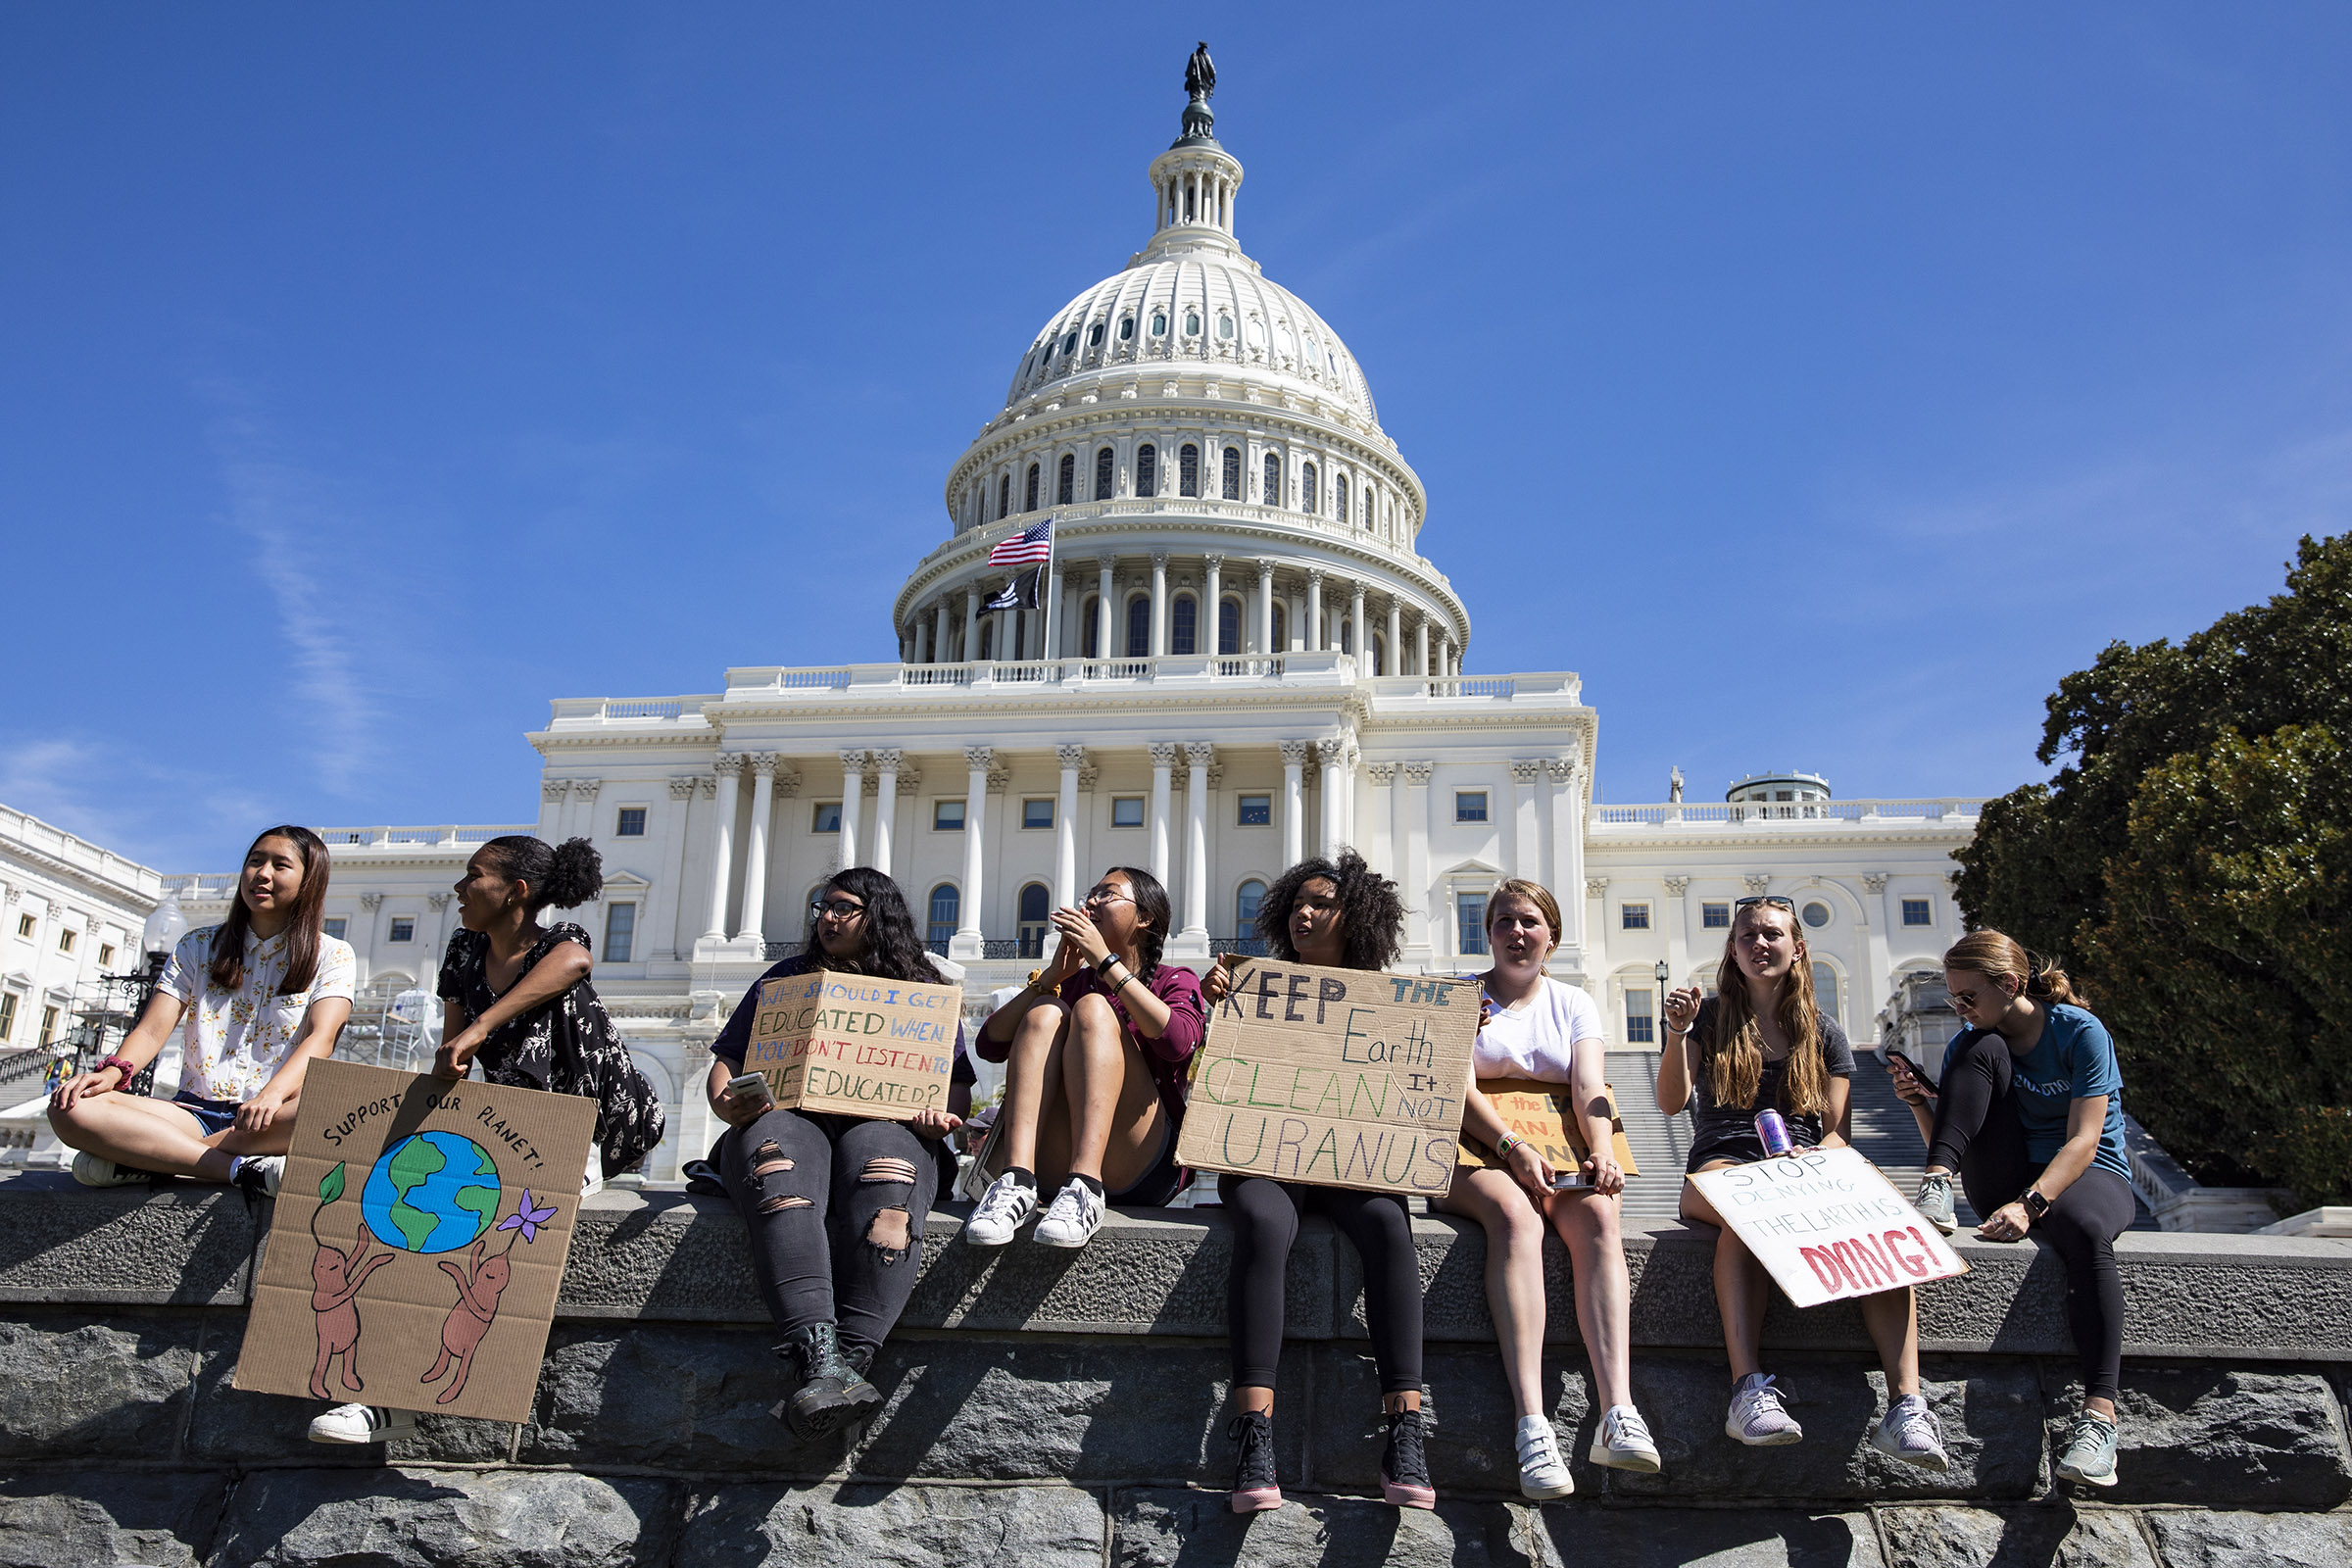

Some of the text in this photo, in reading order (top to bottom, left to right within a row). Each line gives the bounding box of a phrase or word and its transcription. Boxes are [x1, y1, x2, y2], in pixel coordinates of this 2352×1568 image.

[760, 981, 950, 1008] WHY SHOULD I GET
[1223, 963, 1454, 1024] KEEP THE
[760, 1007, 945, 1043] EDUCATED WHEN
[1343, 1007, 1434, 1068] Earth
[755, 1037, 950, 1074] YOU DON'T LISTEN TO
[807, 1066, 941, 1108] EDUCATED?
[1204, 1057, 1390, 1119] CLEAN
[1510, 1096, 1542, 1111] the
[1397, 1096, 1455, 1120] NOT
[323, 1094, 544, 1171] SUPPORT OUR PLANET!
[1223, 1112, 1453, 1190] URANUS
[1723, 1155, 1827, 1187] STOP
[1732, 1179, 1854, 1206] DENYING
[1742, 1198, 1902, 1237] THE EARTH IS
[1798, 1226, 1944, 1296] DYING!
